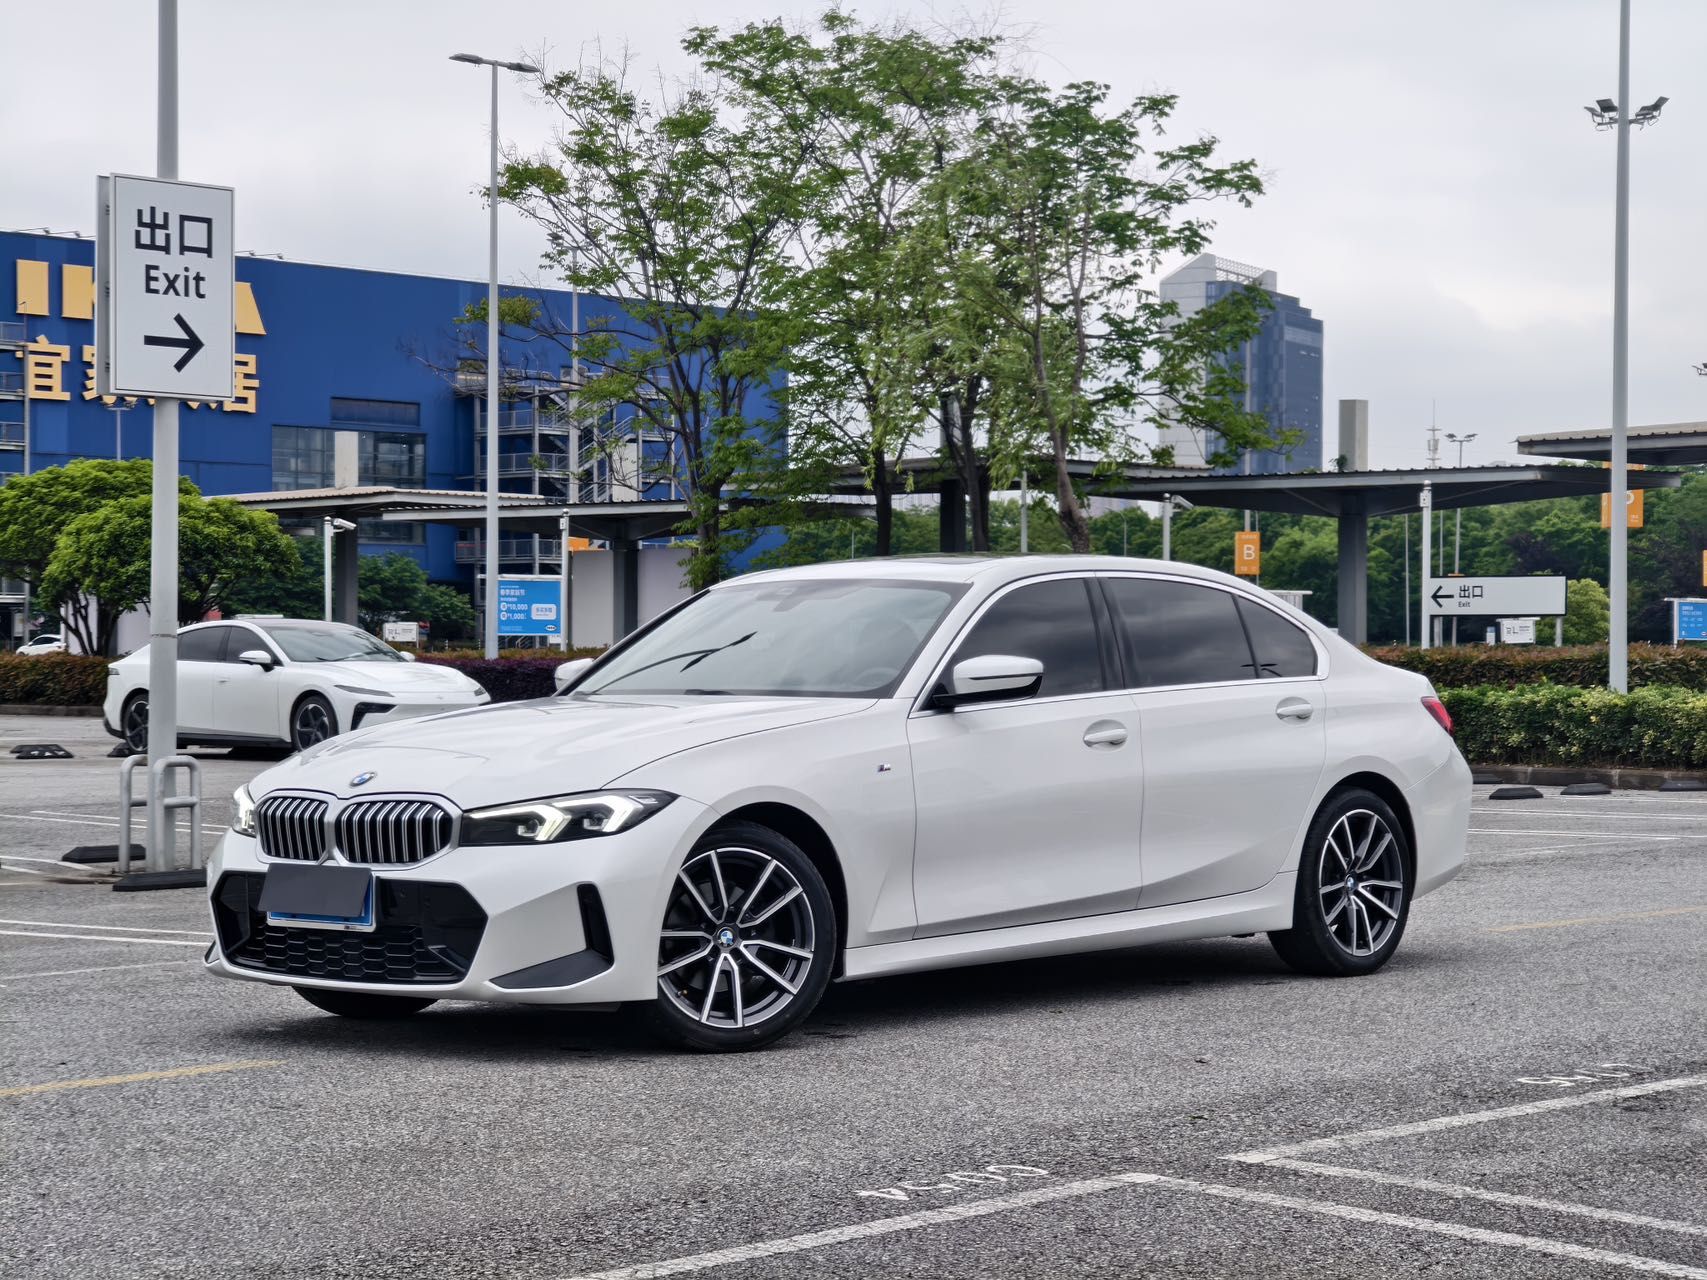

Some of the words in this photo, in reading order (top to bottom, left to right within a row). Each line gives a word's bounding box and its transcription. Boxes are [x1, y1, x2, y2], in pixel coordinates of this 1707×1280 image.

[135, 206, 213, 259] 出口
[144, 264, 207, 299] Exit
[1243, 544, 1256, 560] B
[1459, 584, 1483, 599] 出口
